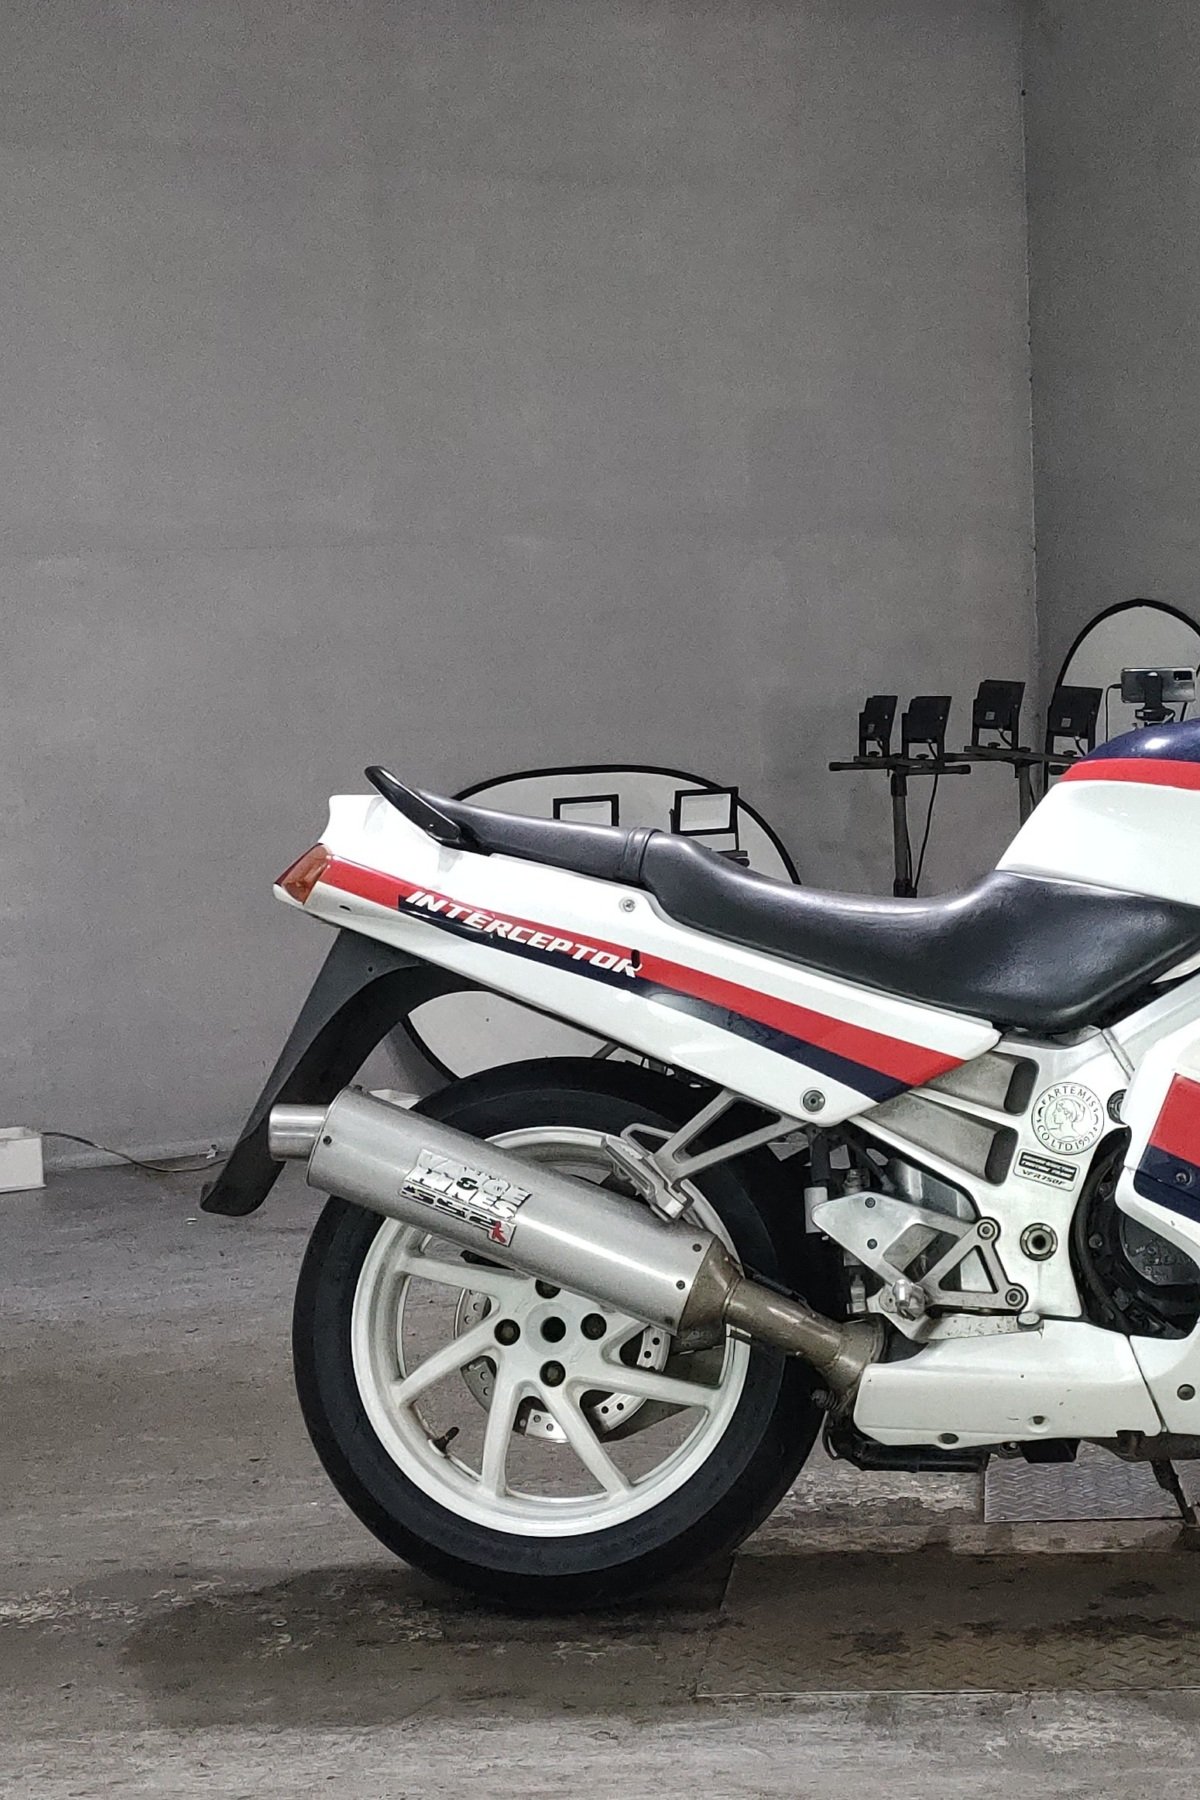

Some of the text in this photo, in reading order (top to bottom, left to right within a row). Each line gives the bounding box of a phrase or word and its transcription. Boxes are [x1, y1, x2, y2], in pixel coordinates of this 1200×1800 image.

[405, 891, 642, 977] INTERCEPTOR
[1048, 1085, 1097, 1108] ARTEMIS
[1050, 1139, 1073, 1152] LTD
